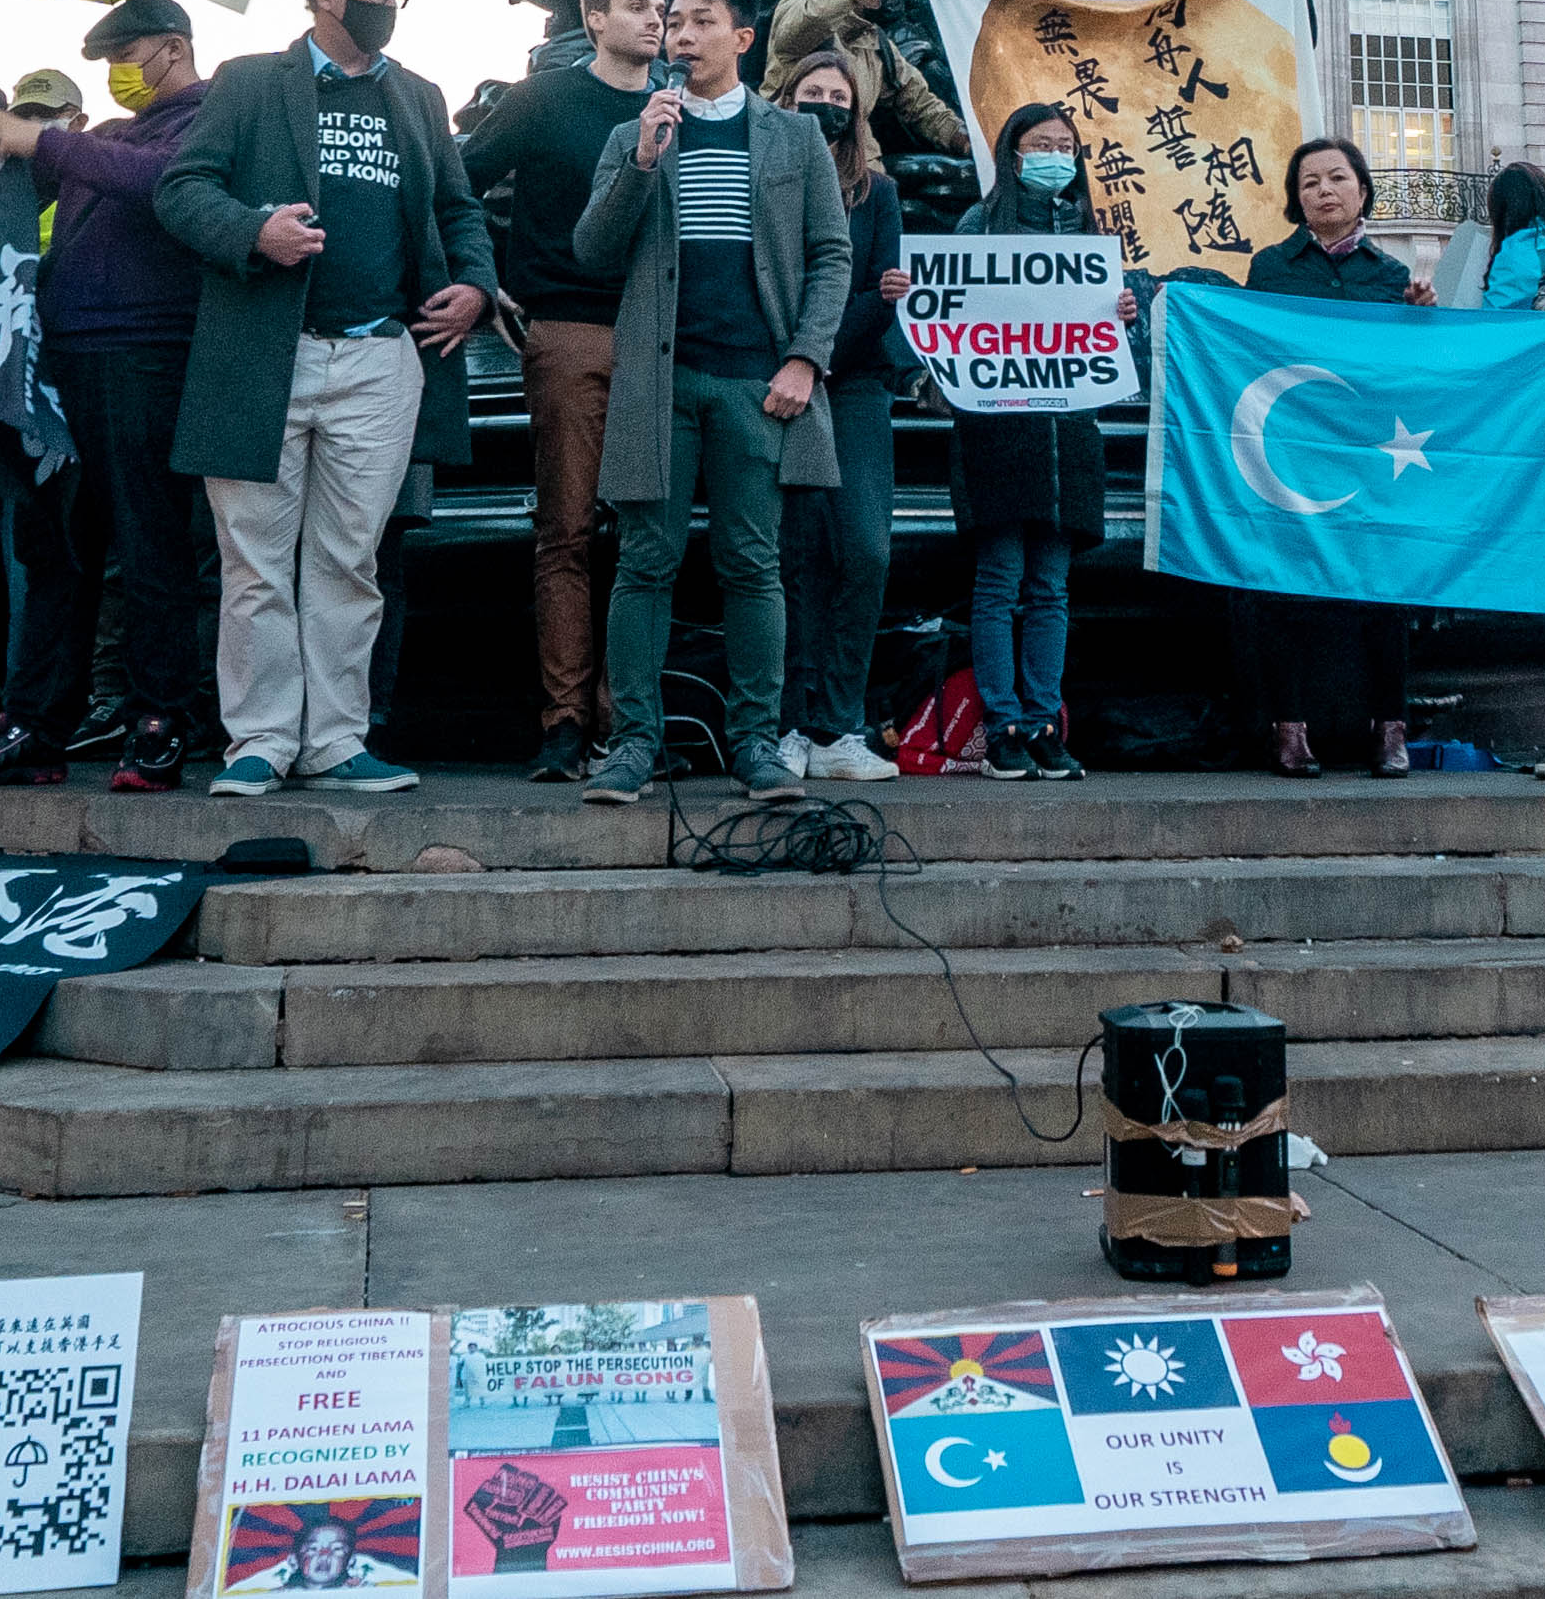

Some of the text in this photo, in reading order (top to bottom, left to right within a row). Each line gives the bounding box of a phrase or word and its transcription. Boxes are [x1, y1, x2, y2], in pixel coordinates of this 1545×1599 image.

[349, 113, 388, 132] FOR
[317, 128, 384, 148] EDOM
[347, 162, 401, 188] KONG
[909, 252, 1108, 286] MILLIONS
[906, 288, 967, 320] OF
[909, 321, 1120, 356] UYGHURS
[921, 355, 1120, 390] IN CAMPS
[257, 1319, 344, 1334] ATROCIOUS
[348, 1316, 395, 1329] CHINA
[278, 1335, 388, 1351] STOP RELIGIOUS
[239, 1349, 424, 1369] PERSECUTION OF TIBETANS
[485, 1354, 694, 1377] HELP STOP THE PERSECUTION
[315, 1369, 347, 1380] AND
[487, 1369, 694, 1392] OF FALUN GONG
[297, 1390, 362, 1411] FREE
[240, 1420, 415, 1443] 11 PANCHEN LAMA
[1105, 1429, 1224, 1450] OUR UNITY
[242, 1443, 411, 1467] RECOGNIZED BY
[569, 1467, 705, 1488] RESIST CHINA'S
[1166, 1461, 1184, 1475] IS
[232, 1469, 417, 1494] H.H. DALAI LAMA
[585, 1482, 690, 1501] COMMUNIST
[610, 1497, 666, 1514] PARTY
[1094, 1486, 1267, 1510] OUR STRENGTH
[573, 1508, 705, 1529] FREEDOM NOW!
[555, 1537, 716, 1559] WWW.RESISTCHINA.ORG
